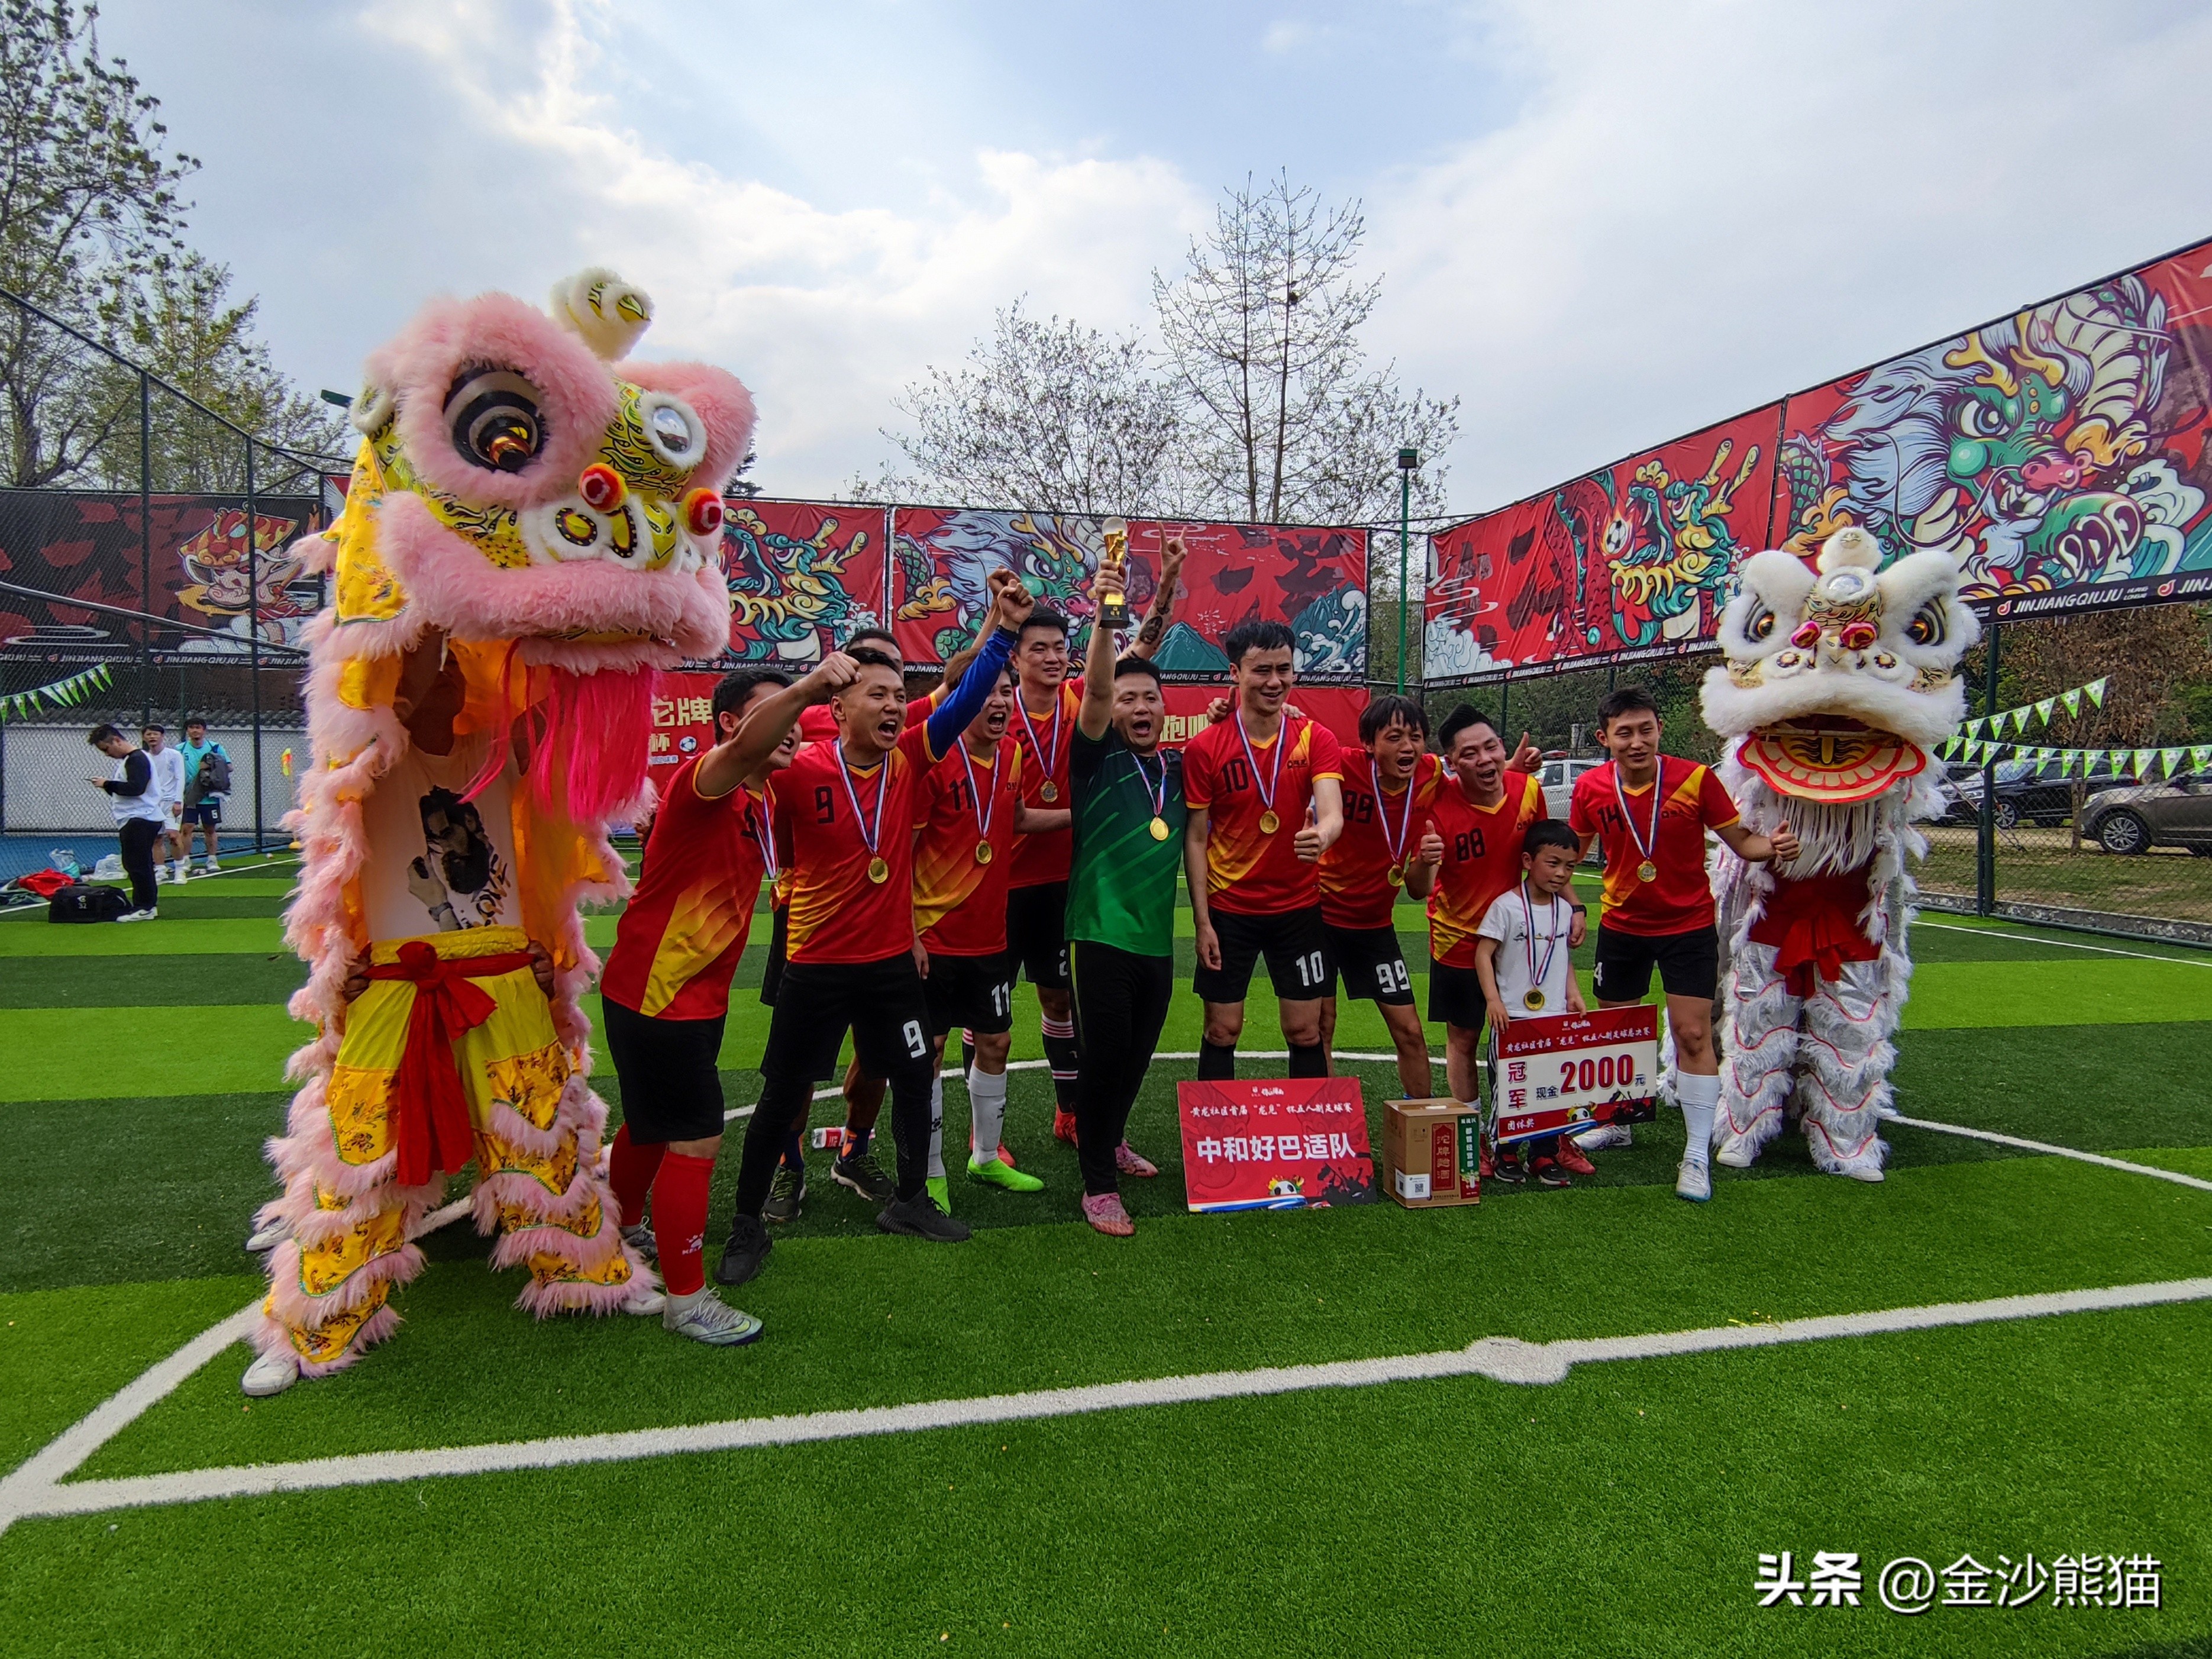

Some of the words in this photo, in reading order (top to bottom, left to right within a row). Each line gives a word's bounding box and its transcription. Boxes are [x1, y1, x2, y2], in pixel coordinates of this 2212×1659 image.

[2013, 588, 2124, 614] JINJIANGQIUJU
[164, 656, 238, 664] JINJIANGQIUJU
[1561, 657, 1601, 670] JINJIANGQIUJU
[1618, 647, 1664, 661] JINJIANGQIUJU
[1222, 757, 1249, 793] 10
[815, 785, 835, 824] 9
[949, 777, 973, 811] 11
[1343, 789, 1375, 824] 99
[1597, 802, 1626, 835] 14
[1454, 827, 1486, 862] 88
[1296, 950, 1325, 987] 10
[1375, 959, 1411, 993] 99
[991, 981, 1010, 1017] 11
[903, 1019, 926, 1058] 9
[1508, 1061, 1528, 1111] 冠军
[1536, 1086, 1559, 1100] 现金
[1560, 1053, 1635, 1095] 2000
[1635, 1073, 1647, 1086] 元
[1196, 1132, 1357, 1164] 中和好巴适队
